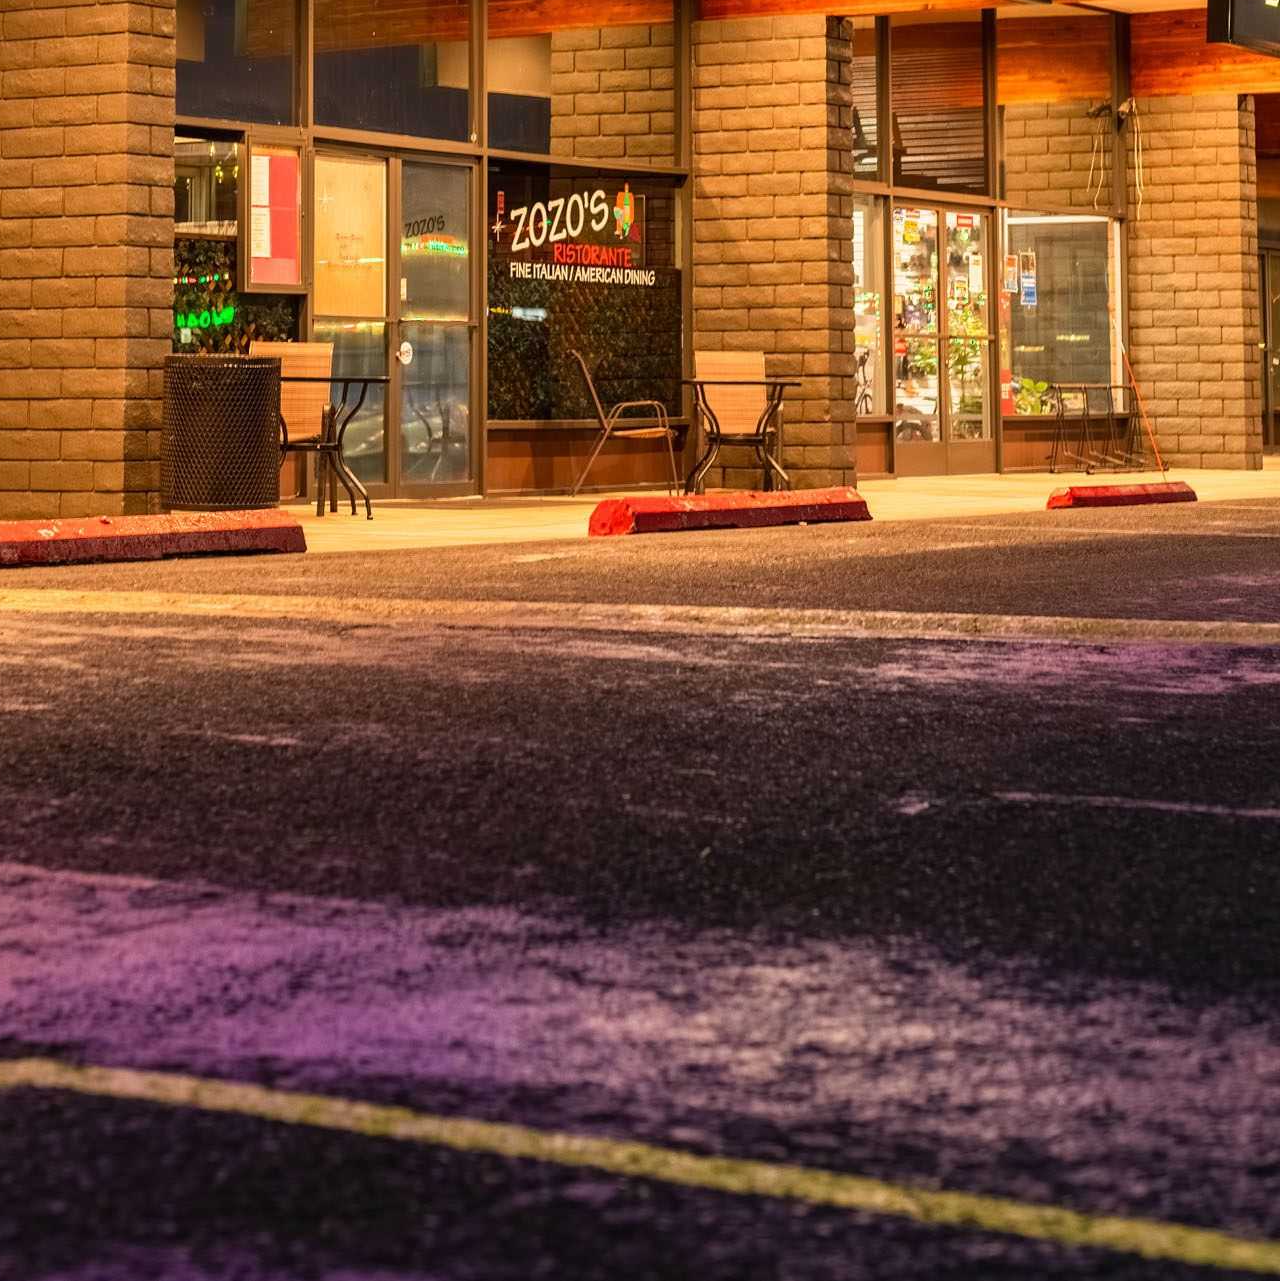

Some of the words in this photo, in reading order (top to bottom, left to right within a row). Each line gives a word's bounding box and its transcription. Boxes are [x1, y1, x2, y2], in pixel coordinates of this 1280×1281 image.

[404, 215, 446, 238] ZOZO'S
[510, 189, 609, 253] ZOZO'S
[553, 242, 633, 268] RISTORANTE
[510, 261, 531, 279] FINE
[533, 263, 569, 281] ITALIAN
[574, 266, 624, 284] AMERICAN
[625, 269, 655, 286] DINING
